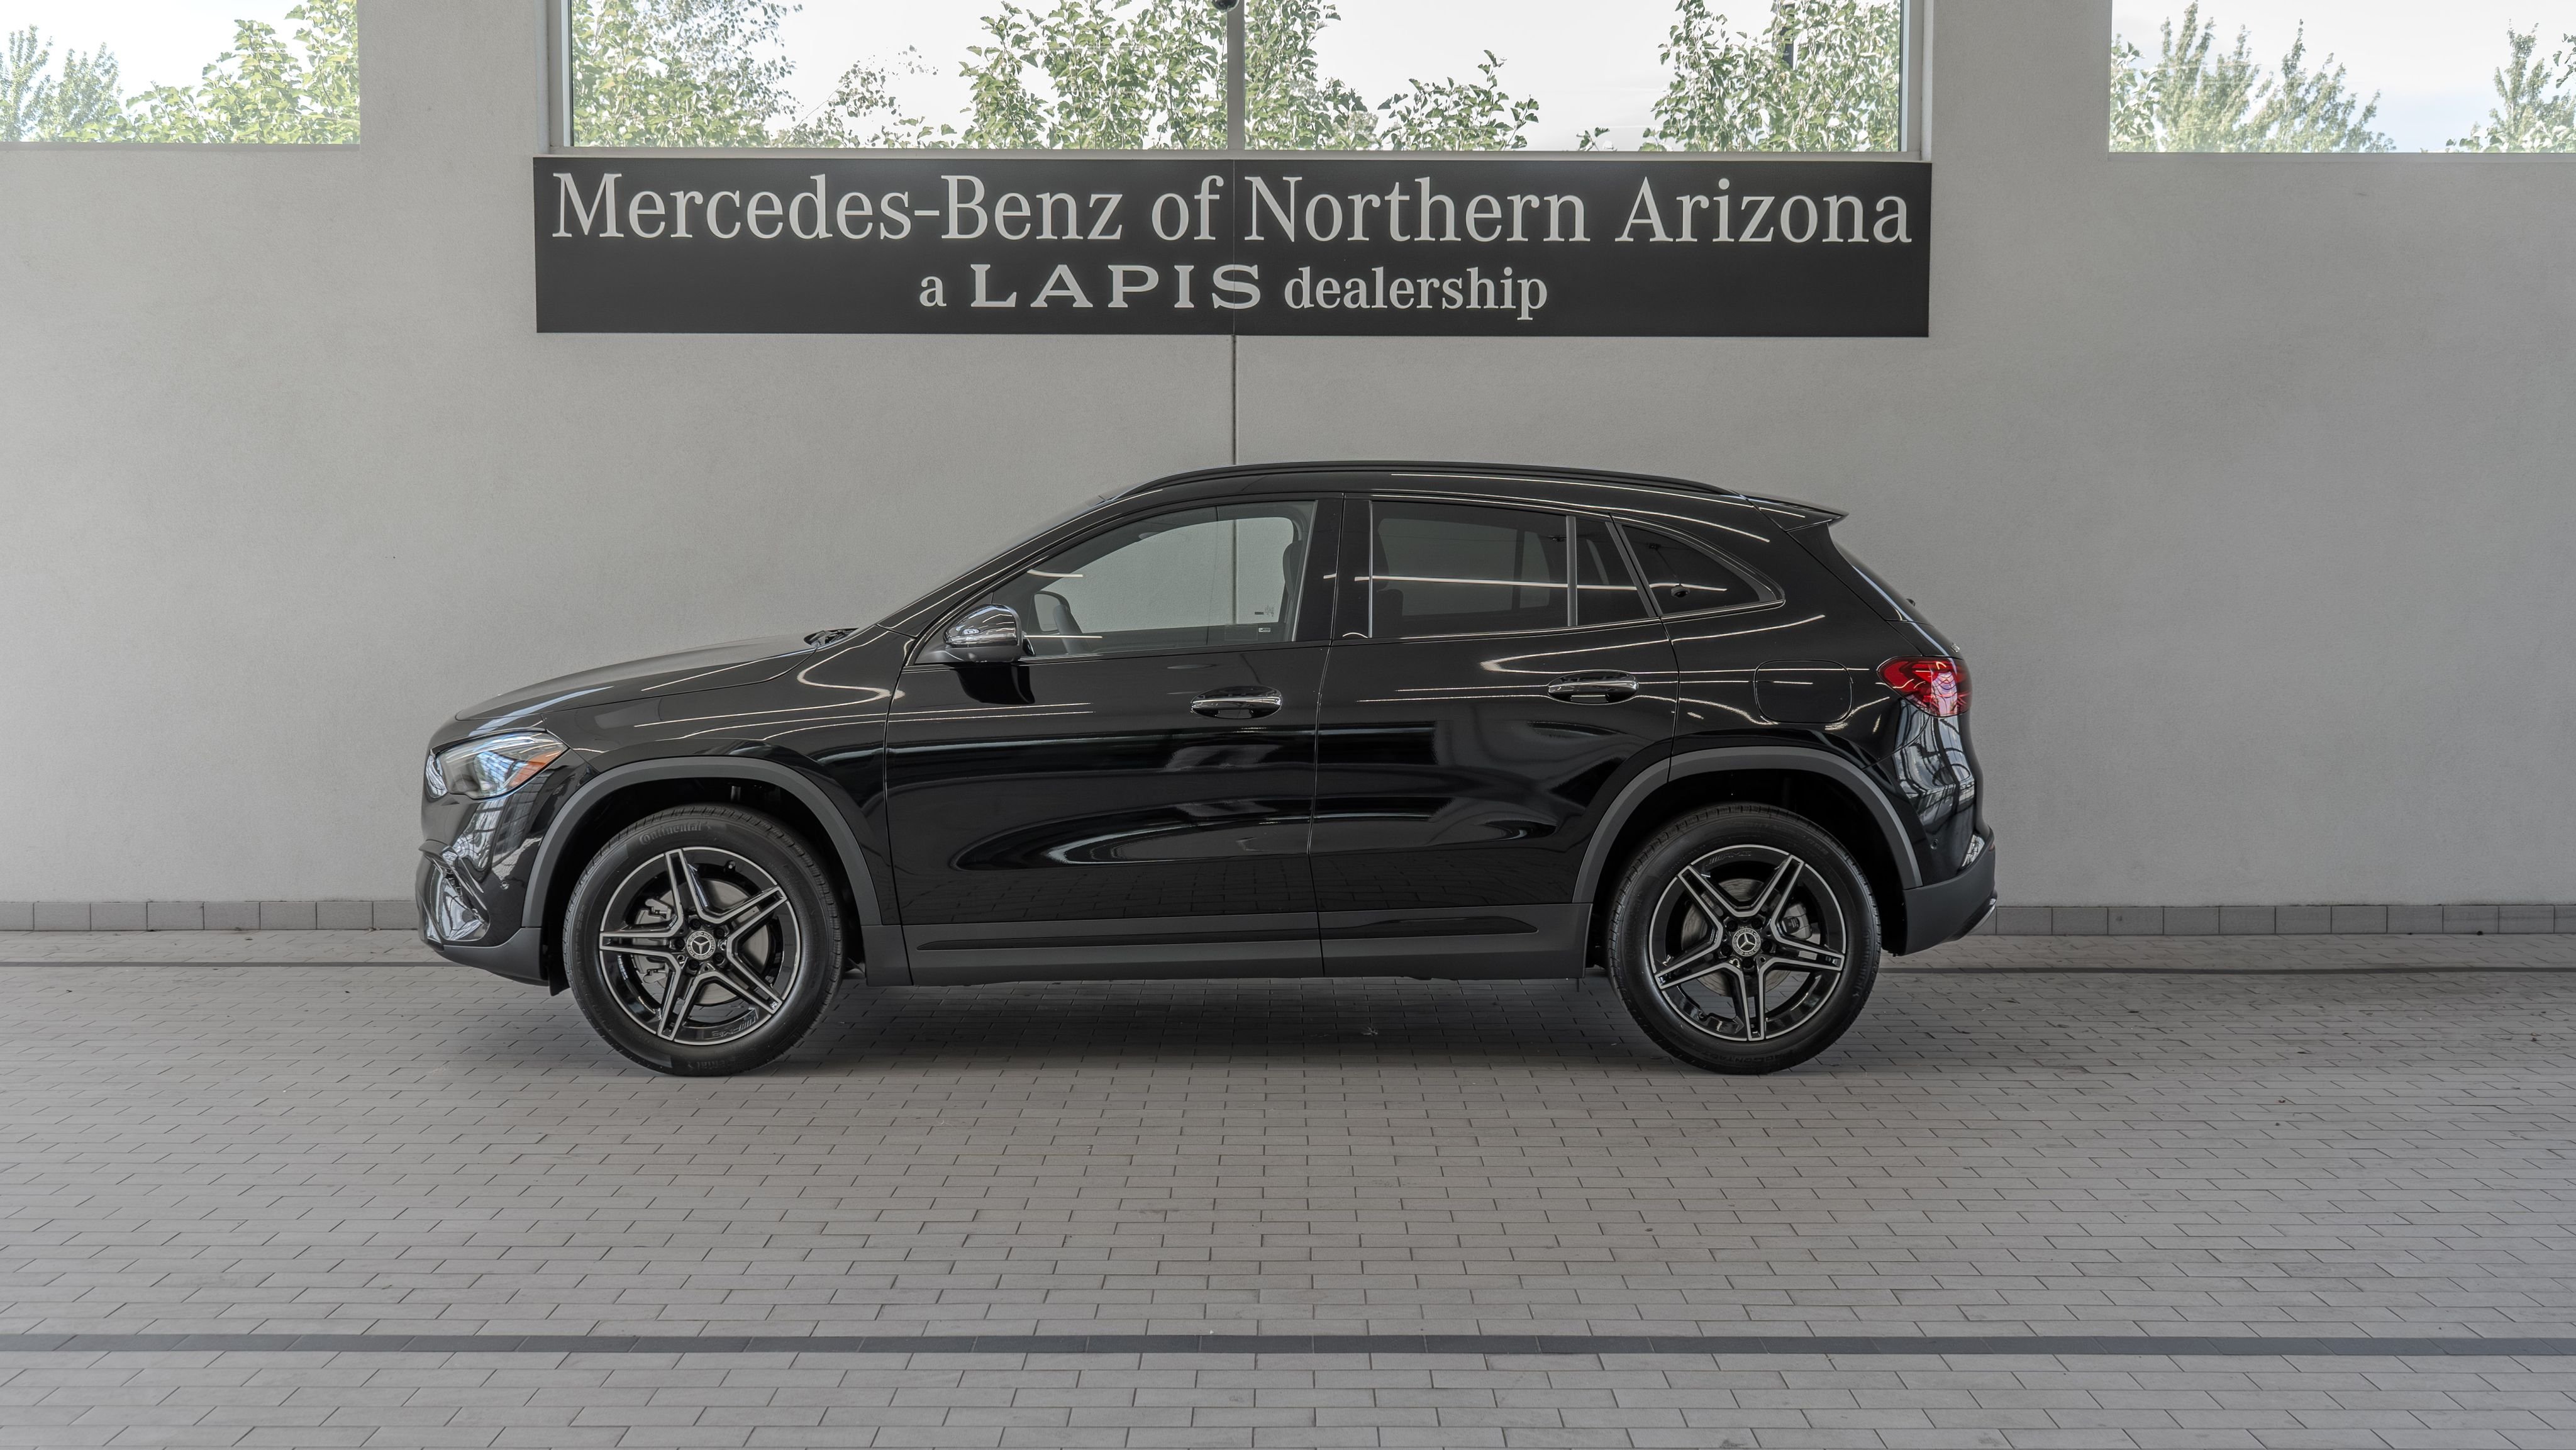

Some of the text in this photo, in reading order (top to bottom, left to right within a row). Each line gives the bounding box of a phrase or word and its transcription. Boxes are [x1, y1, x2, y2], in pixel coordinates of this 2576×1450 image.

[552, 172, 1913, 243] Mercedes-Benz of Northern Arizona
[919, 264, 1548, 321] a LAPIS dealership
[639, 821, 702, 845] Continental
